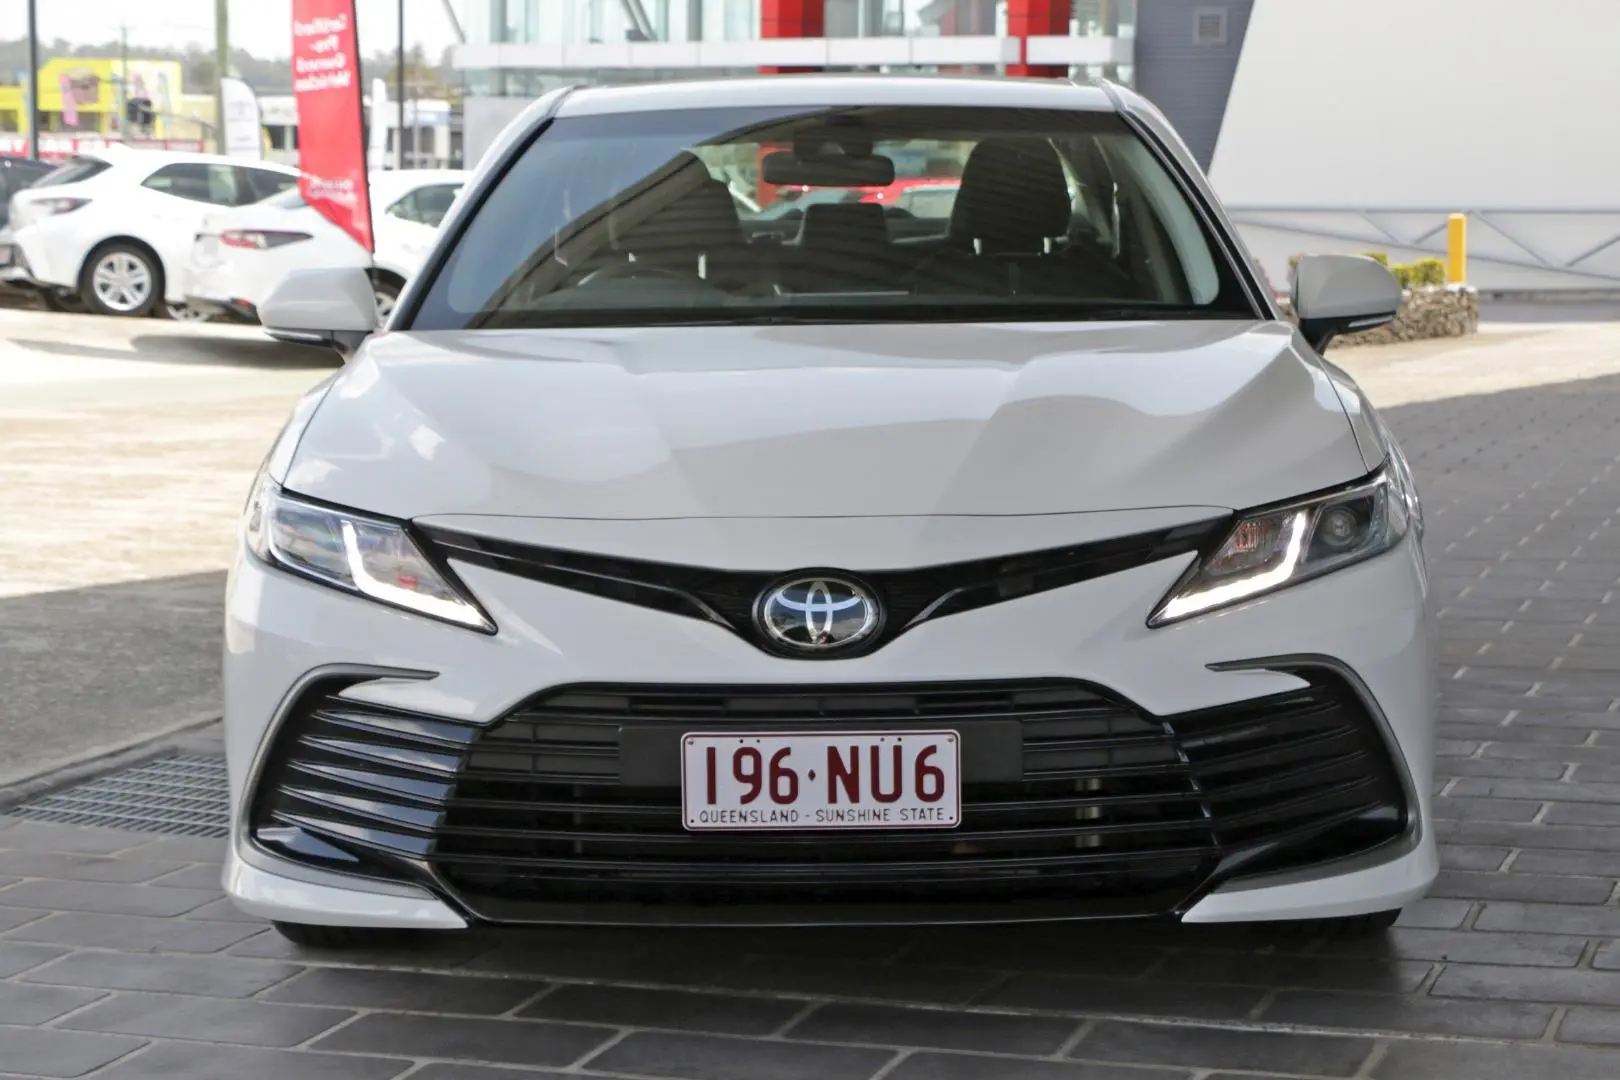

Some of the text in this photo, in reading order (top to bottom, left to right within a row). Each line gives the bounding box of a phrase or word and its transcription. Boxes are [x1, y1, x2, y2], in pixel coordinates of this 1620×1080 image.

[700, 810, 799, 824] QUEENSLAND
[815, 808, 891, 822] SUNSHINE
[900, 807, 945, 822] STATE
